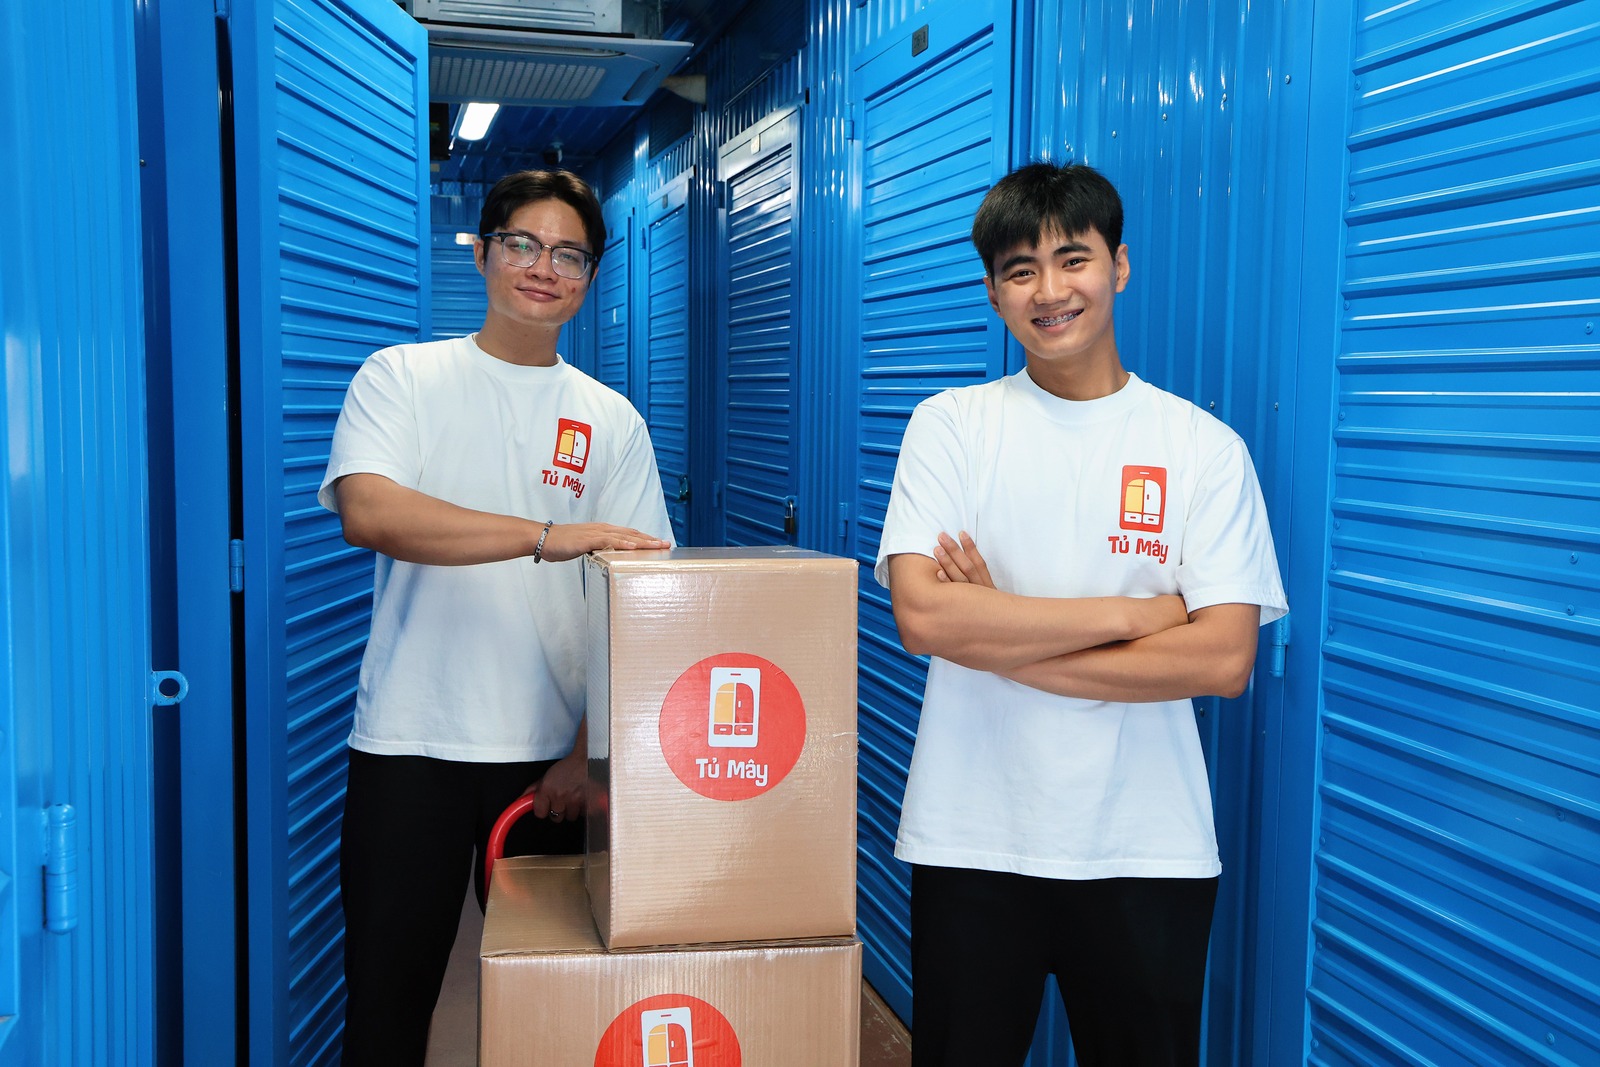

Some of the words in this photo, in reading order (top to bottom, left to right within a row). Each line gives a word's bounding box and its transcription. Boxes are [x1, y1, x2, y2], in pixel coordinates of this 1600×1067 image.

[542, 469, 559, 486] Tủ
[562, 474, 586, 499] Mây
[1108, 535, 1129, 554] Tủ
[1135, 538, 1169, 564] Mây
[695, 757, 720, 778] Tủ
[727, 759, 768, 787] Mây
